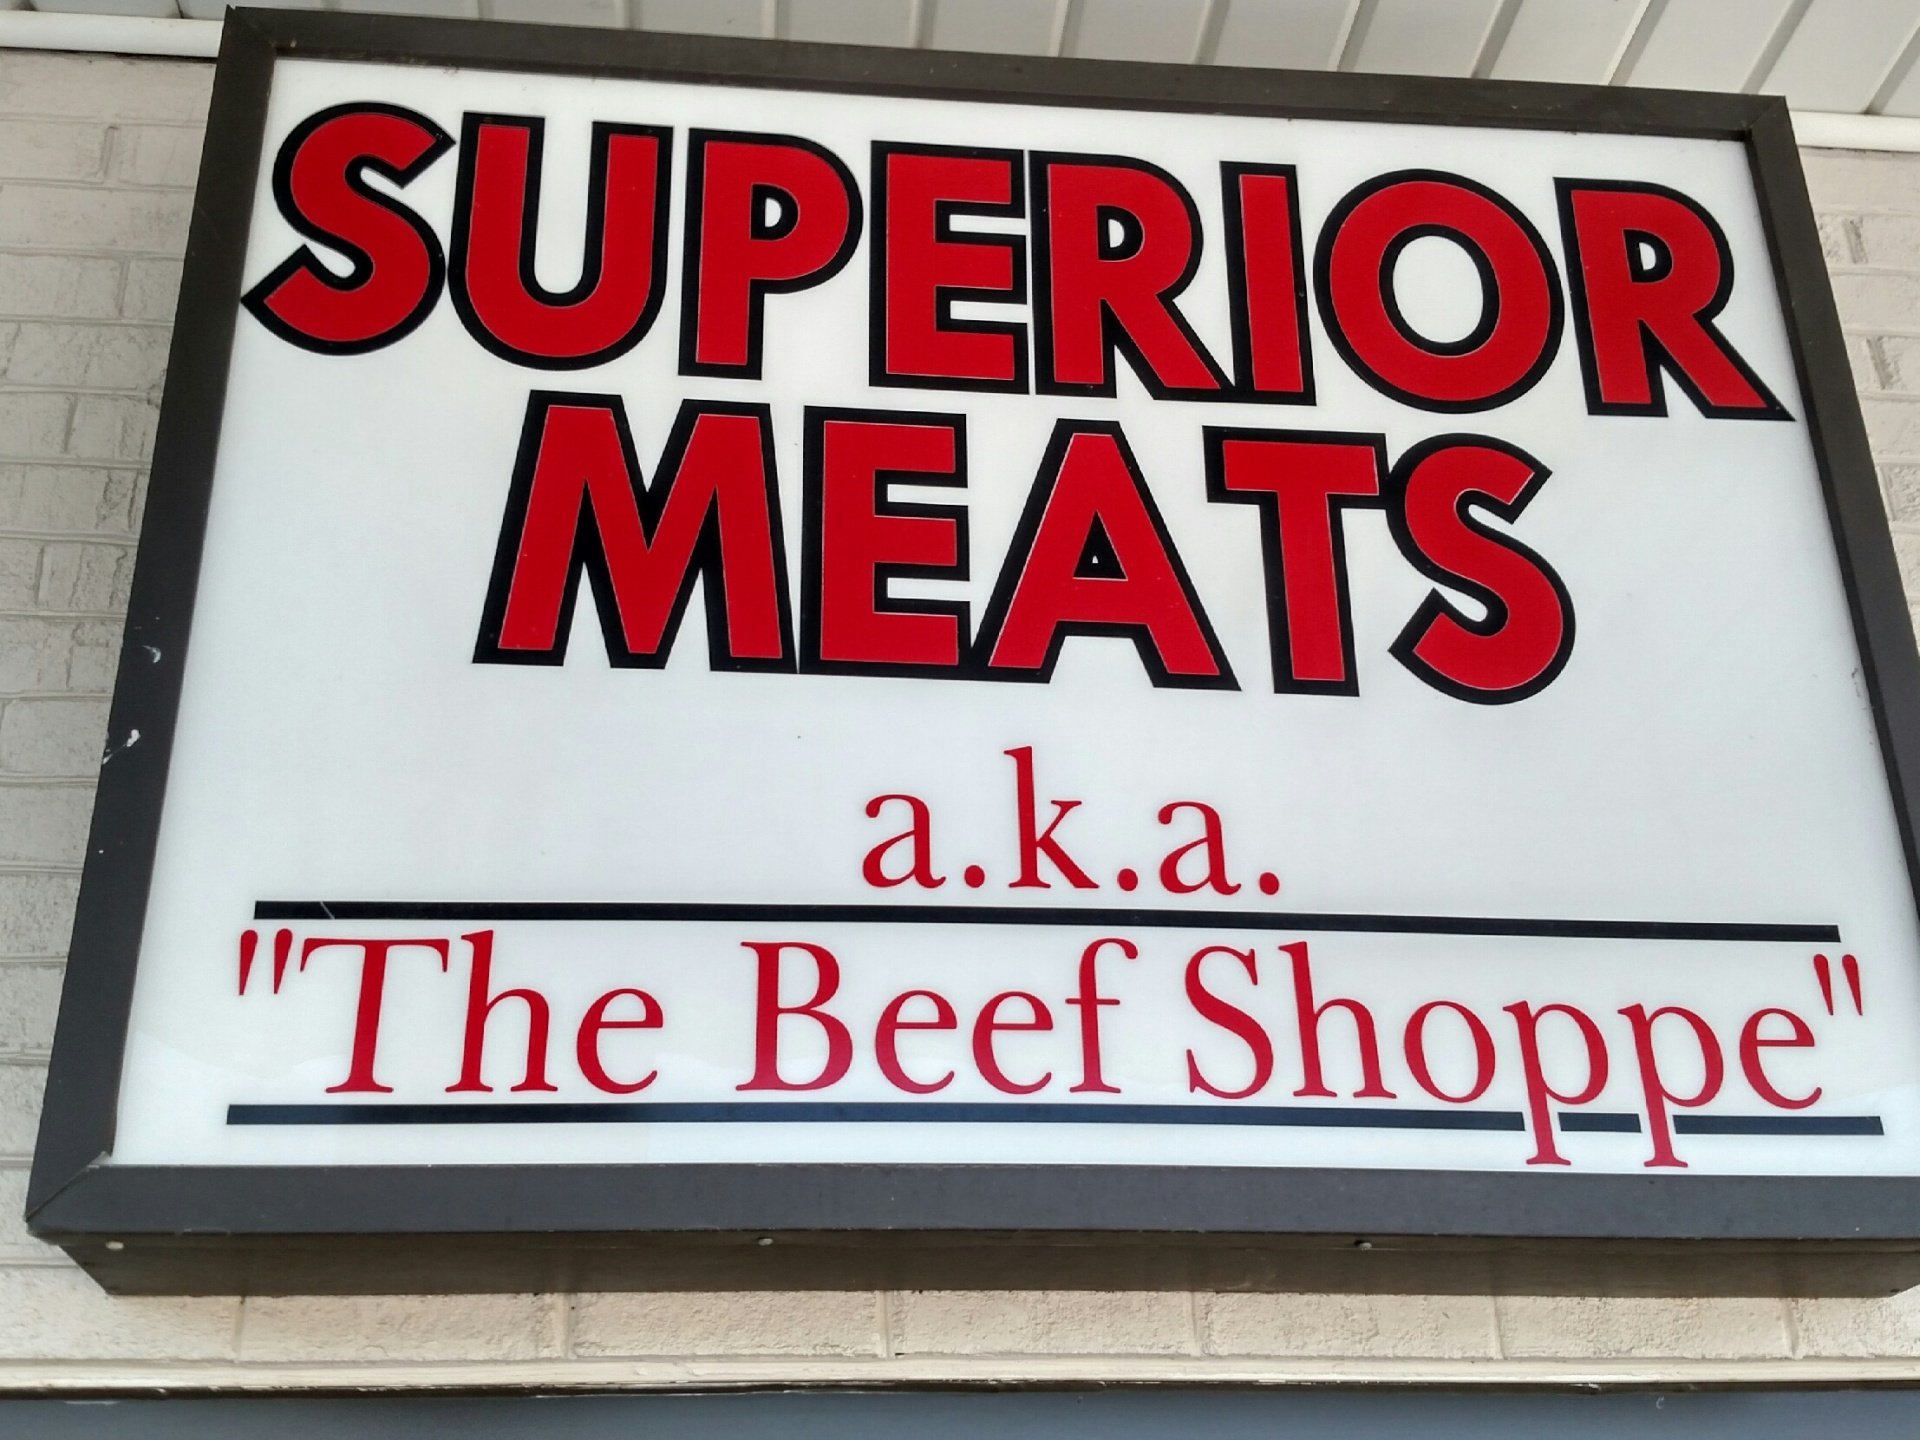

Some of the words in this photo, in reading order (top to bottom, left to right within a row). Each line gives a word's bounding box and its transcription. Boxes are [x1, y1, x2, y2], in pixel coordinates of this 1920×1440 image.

[241, 102, 1797, 422] SUPERIOR
[472, 390, 1574, 705] MEATS
[862, 745, 1280, 896] a.k.a.
[238, 929, 664, 1095] "The
[735, 937, 1138, 1095] Beef
[1184, 941, 1862, 1168] Shoppe"
